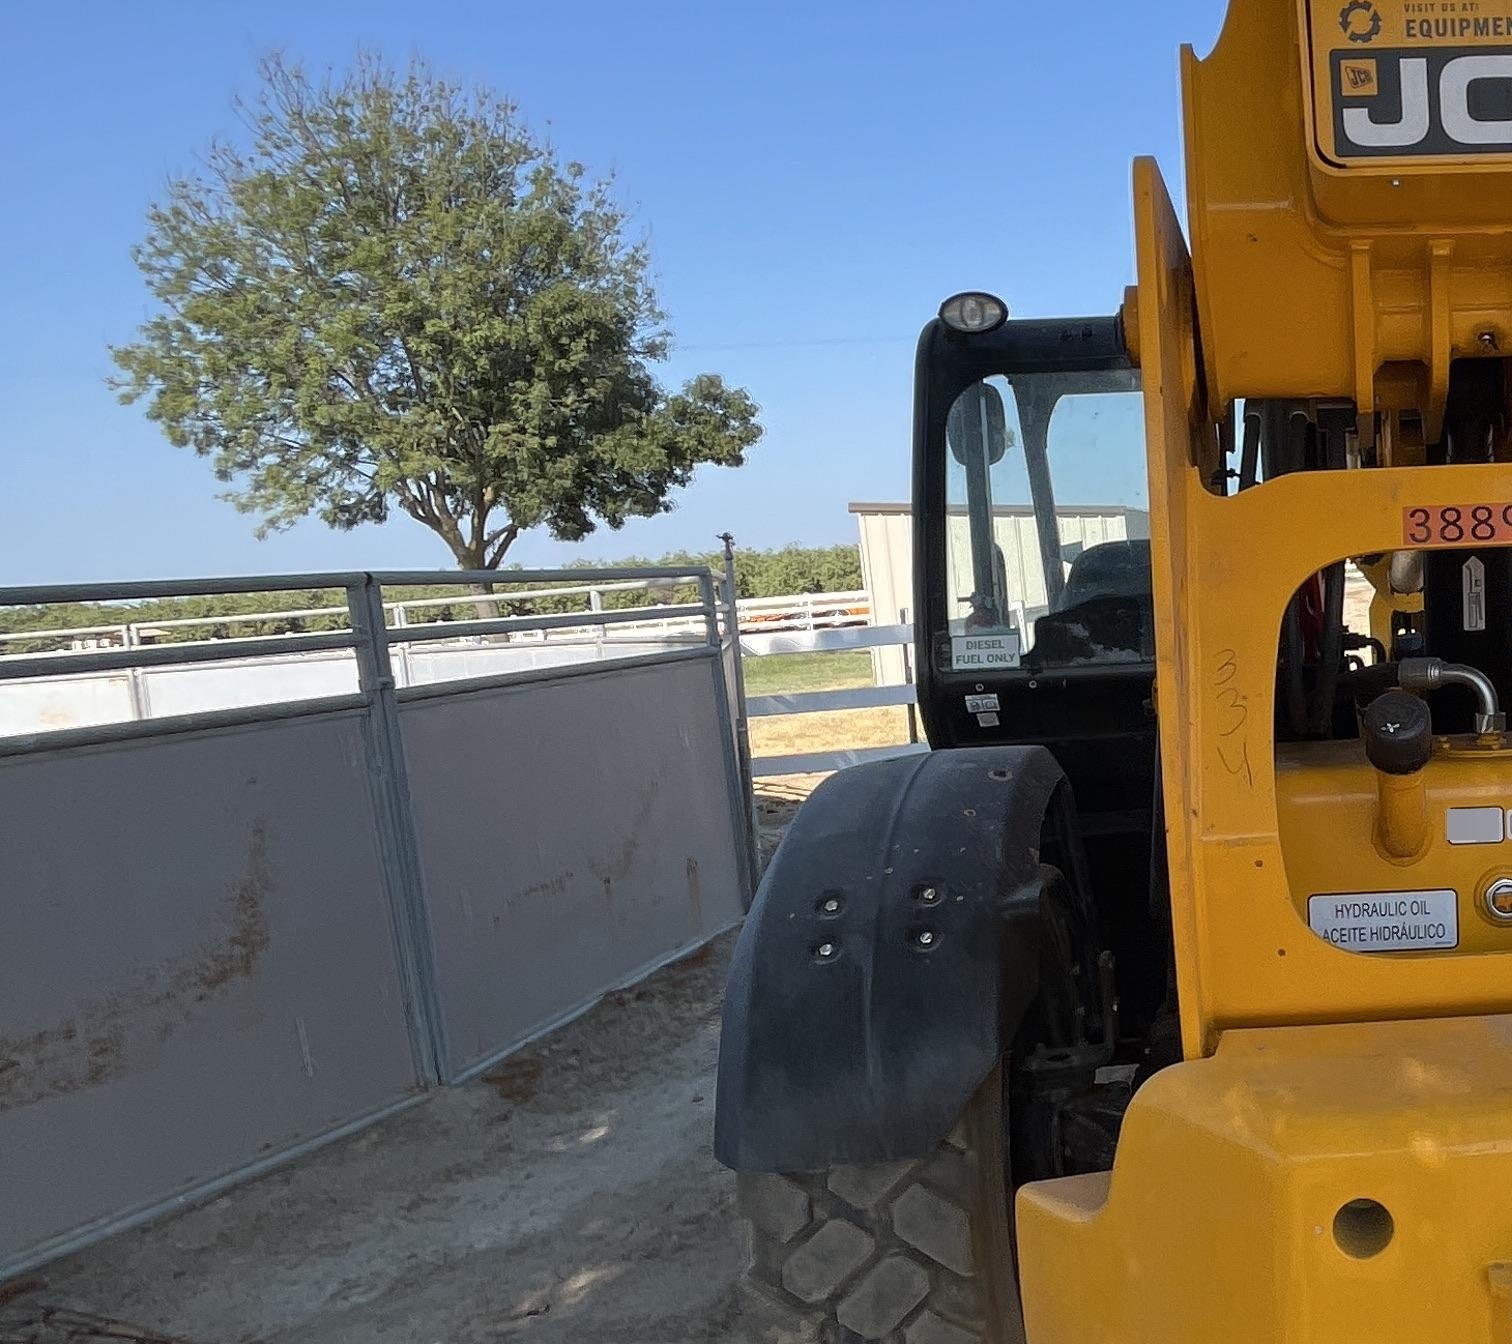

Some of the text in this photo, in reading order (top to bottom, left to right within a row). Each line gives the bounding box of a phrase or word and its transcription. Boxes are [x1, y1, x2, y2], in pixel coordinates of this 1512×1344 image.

[1403, 3, 1435, 13] VISIT
[1440, 3, 1457, 12] US
[965, 639, 1005, 650] DIESEL
[955, 653, 1016, 664] FUEL ONLY
[1335, 900, 1431, 919] HYDRAULIC OIL
[1322, 921, 1446, 944] ACEITE HIDRÁULICO
